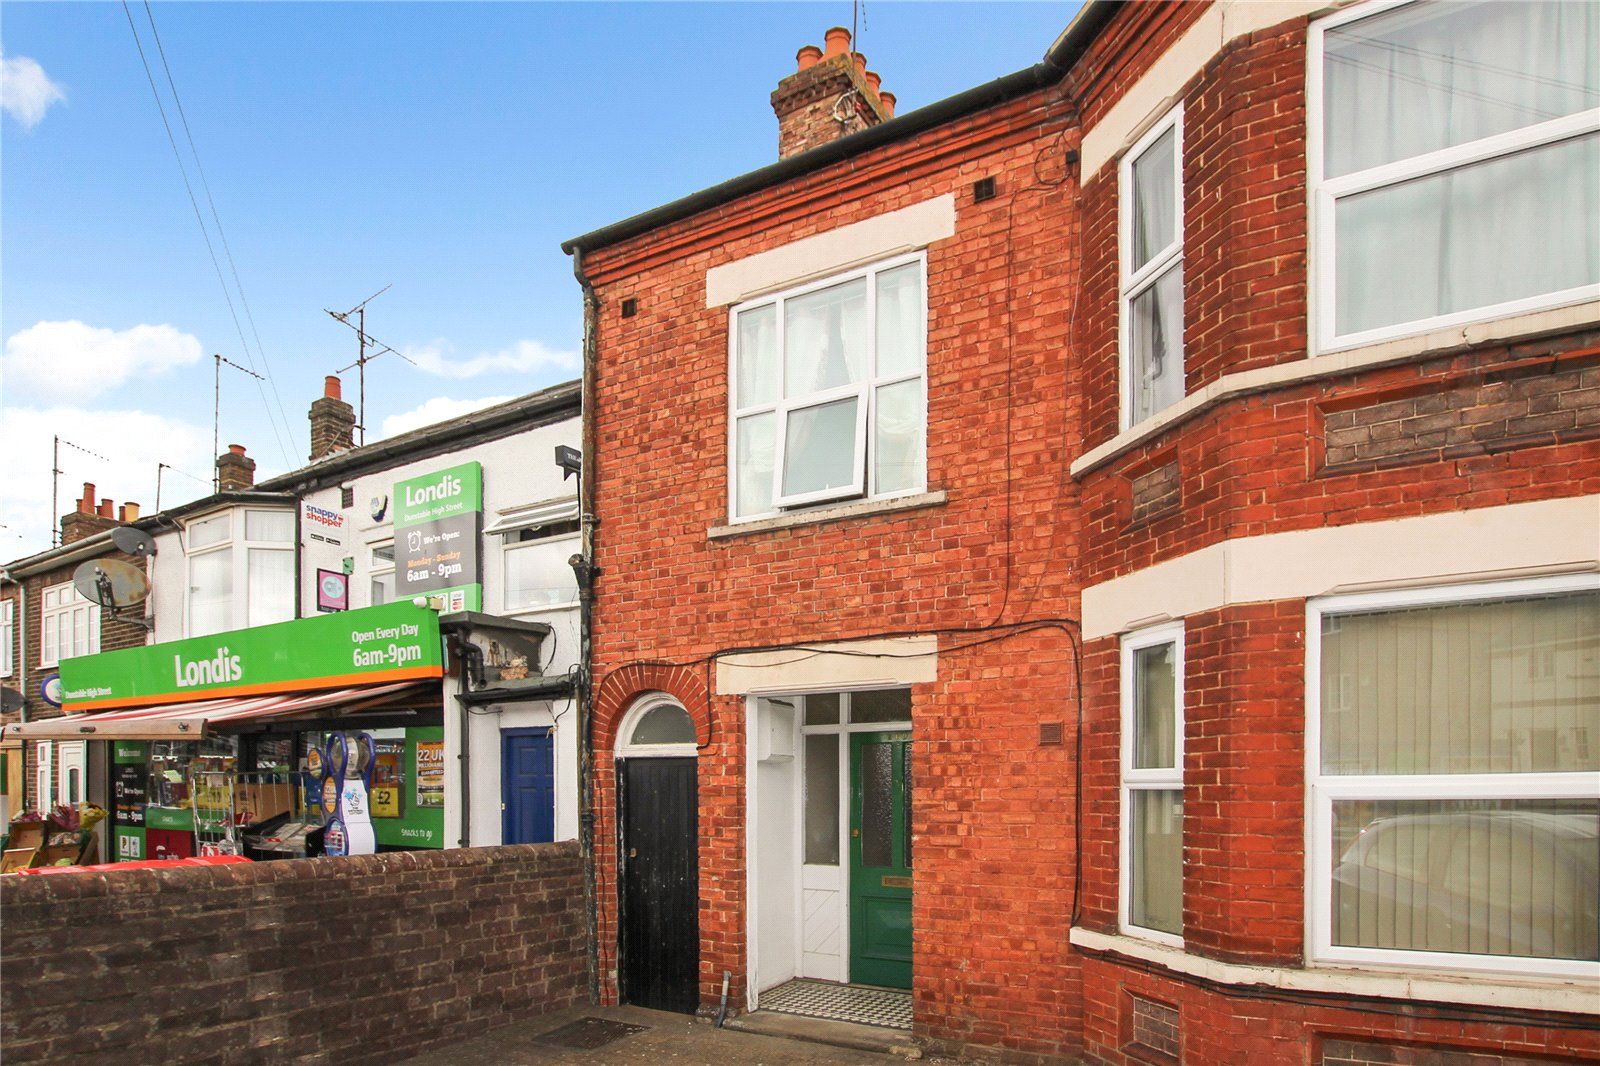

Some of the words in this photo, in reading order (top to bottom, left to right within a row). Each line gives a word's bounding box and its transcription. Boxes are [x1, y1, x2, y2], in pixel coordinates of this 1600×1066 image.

[406, 475, 462, 508] Londis
[306, 505, 338, 520] snappy
[445, 502, 463, 513] Street
[306, 512, 342, 528] shopper
[423, 534, 441, 545] We're
[407, 556, 432, 568] Monday
[436, 551, 461, 563] Sunday
[407, 569, 429, 582] 6am
[438, 563, 462, 578] 9pm
[352, 631, 375, 644] Open
[376, 627, 400, 639] Every
[401, 624, 419, 637] Day
[353, 643, 422, 667] 6am-9pm
[174, 645, 242, 688] Londis
[418, 749, 430, 761] 22
[378, 791, 391, 805] £2
